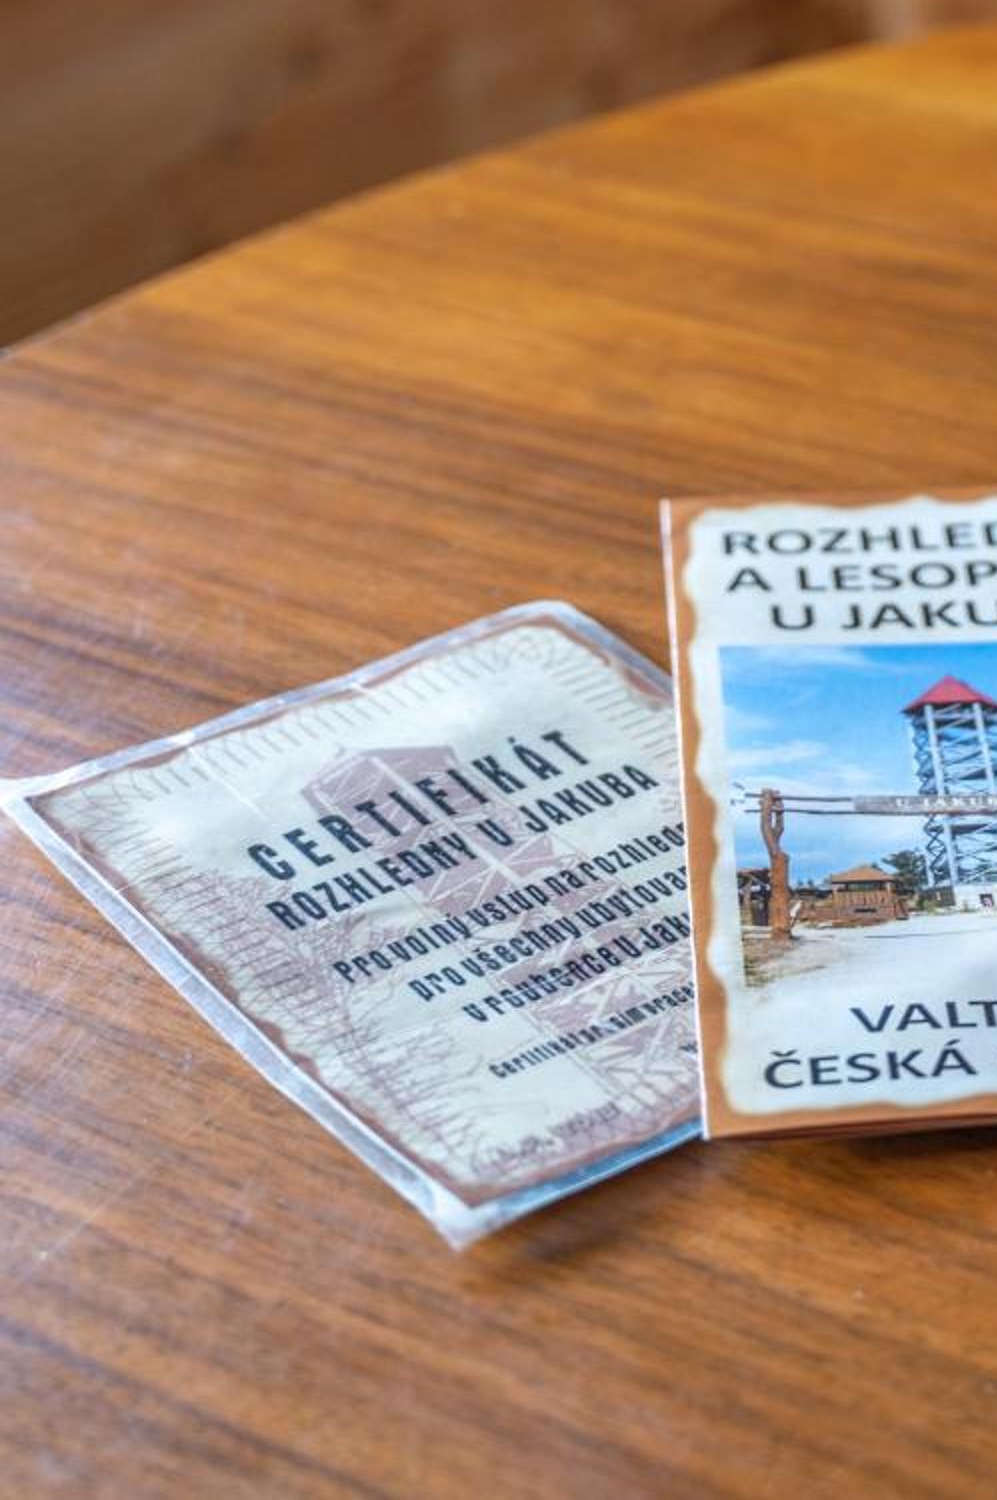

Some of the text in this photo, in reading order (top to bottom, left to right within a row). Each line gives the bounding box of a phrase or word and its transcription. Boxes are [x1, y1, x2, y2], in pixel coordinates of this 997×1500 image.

[727, 568, 772, 592] A
[772, 606, 814, 630] U
[247, 730, 589, 880] CERTIFIKÁT
[266, 764, 661, 931] ROZHLEDNY U JAKUBA
[469, 883, 549, 927] vstup
[547, 868, 585, 898] na
[581, 821, 687, 882] rozhled
[407, 866, 688, 1001] pro všechny ubytova
[461, 1003, 489, 1023] v
[611, 932, 642, 959] U
[639, 911, 690, 951] Jak
[764, 1039, 977, 1089] ČESKÁ
